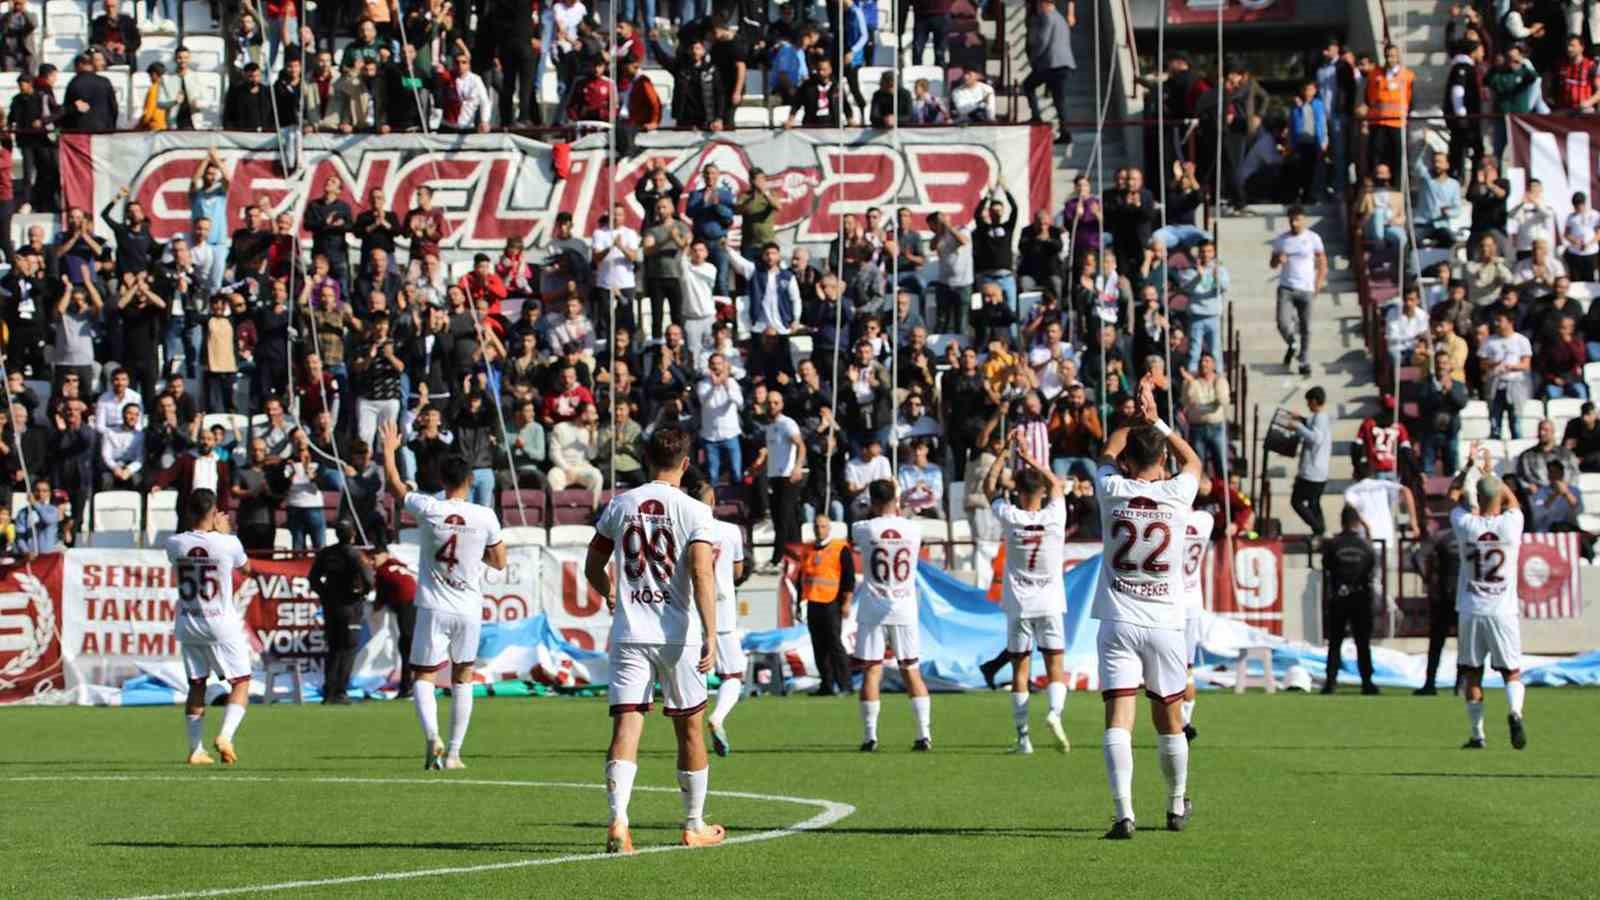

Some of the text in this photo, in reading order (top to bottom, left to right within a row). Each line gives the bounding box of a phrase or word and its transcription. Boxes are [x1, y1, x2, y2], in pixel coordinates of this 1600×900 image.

[797, 144, 998, 242] 23
[435, 533, 460, 574] 4
[622, 525, 675, 583] 99
[1023, 536, 1043, 572] 7
[1112, 519, 1171, 572] 22
[178, 565, 218, 602] 55
[870, 548, 910, 584] 66
[1466, 549, 1505, 582] 12
[631, 585, 672, 605] KÖSE
